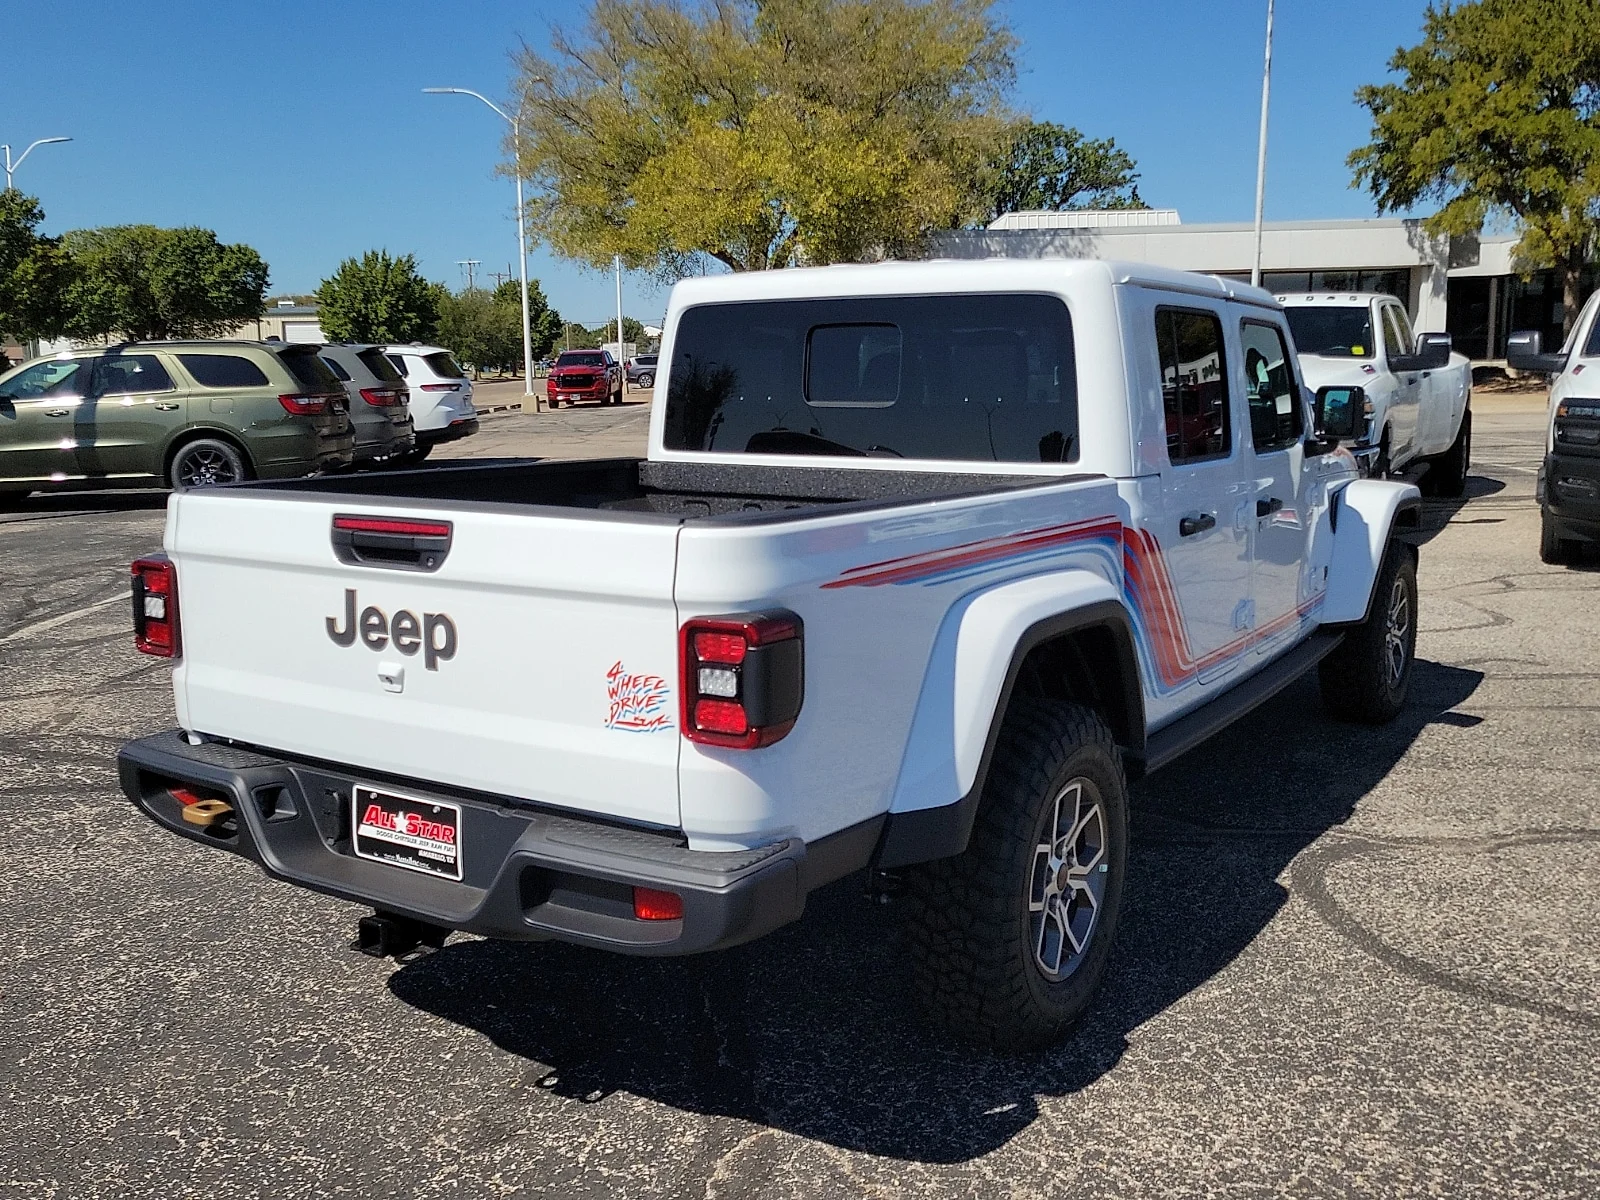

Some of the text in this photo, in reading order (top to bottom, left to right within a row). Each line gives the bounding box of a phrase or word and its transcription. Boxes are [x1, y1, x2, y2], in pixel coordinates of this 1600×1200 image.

[326, 588, 458, 671] Jeep
[606, 660, 624, 682] 4
[607, 674, 667, 699] WHEEL
[609, 693, 663, 724] DRIVE
